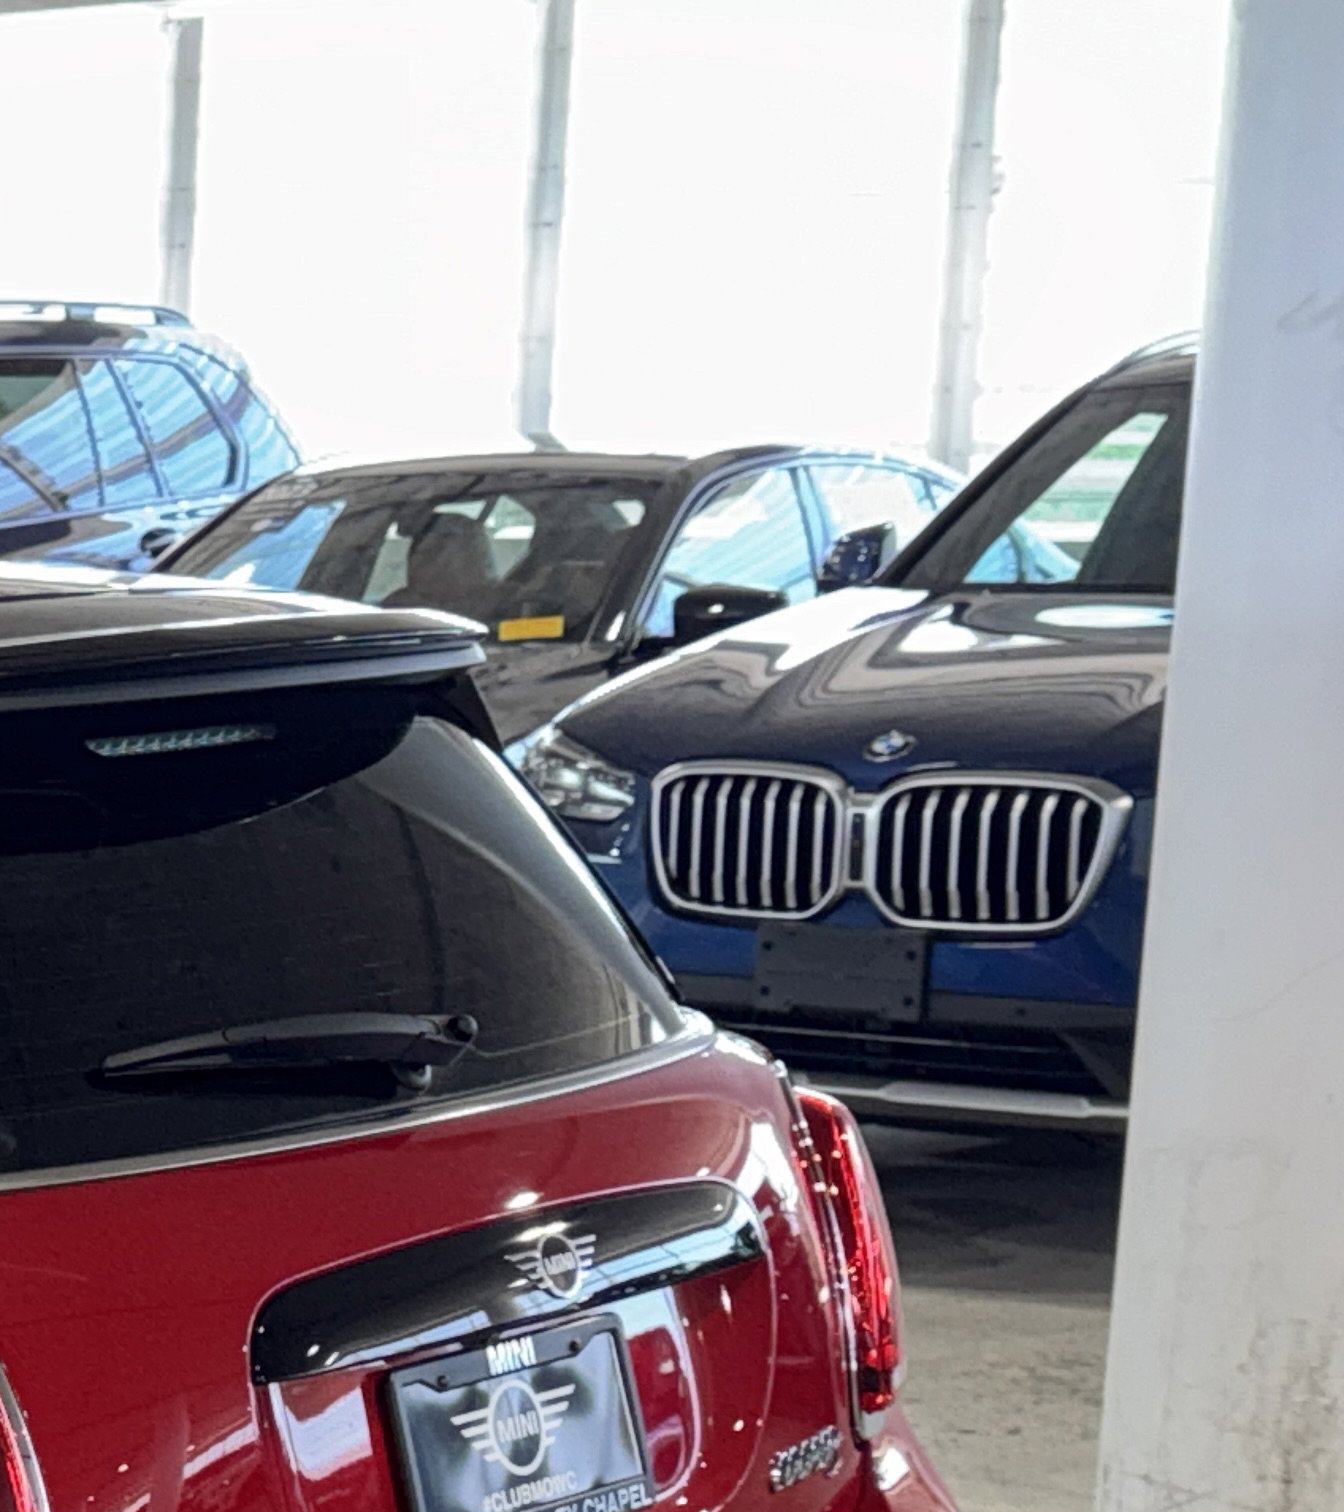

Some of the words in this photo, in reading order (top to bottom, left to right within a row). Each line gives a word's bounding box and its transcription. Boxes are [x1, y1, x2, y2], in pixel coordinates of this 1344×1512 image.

[543, 1252, 577, 1275] MINI
[486, 1335, 537, 1376] MINI
[496, 1411, 540, 1442] MINI
